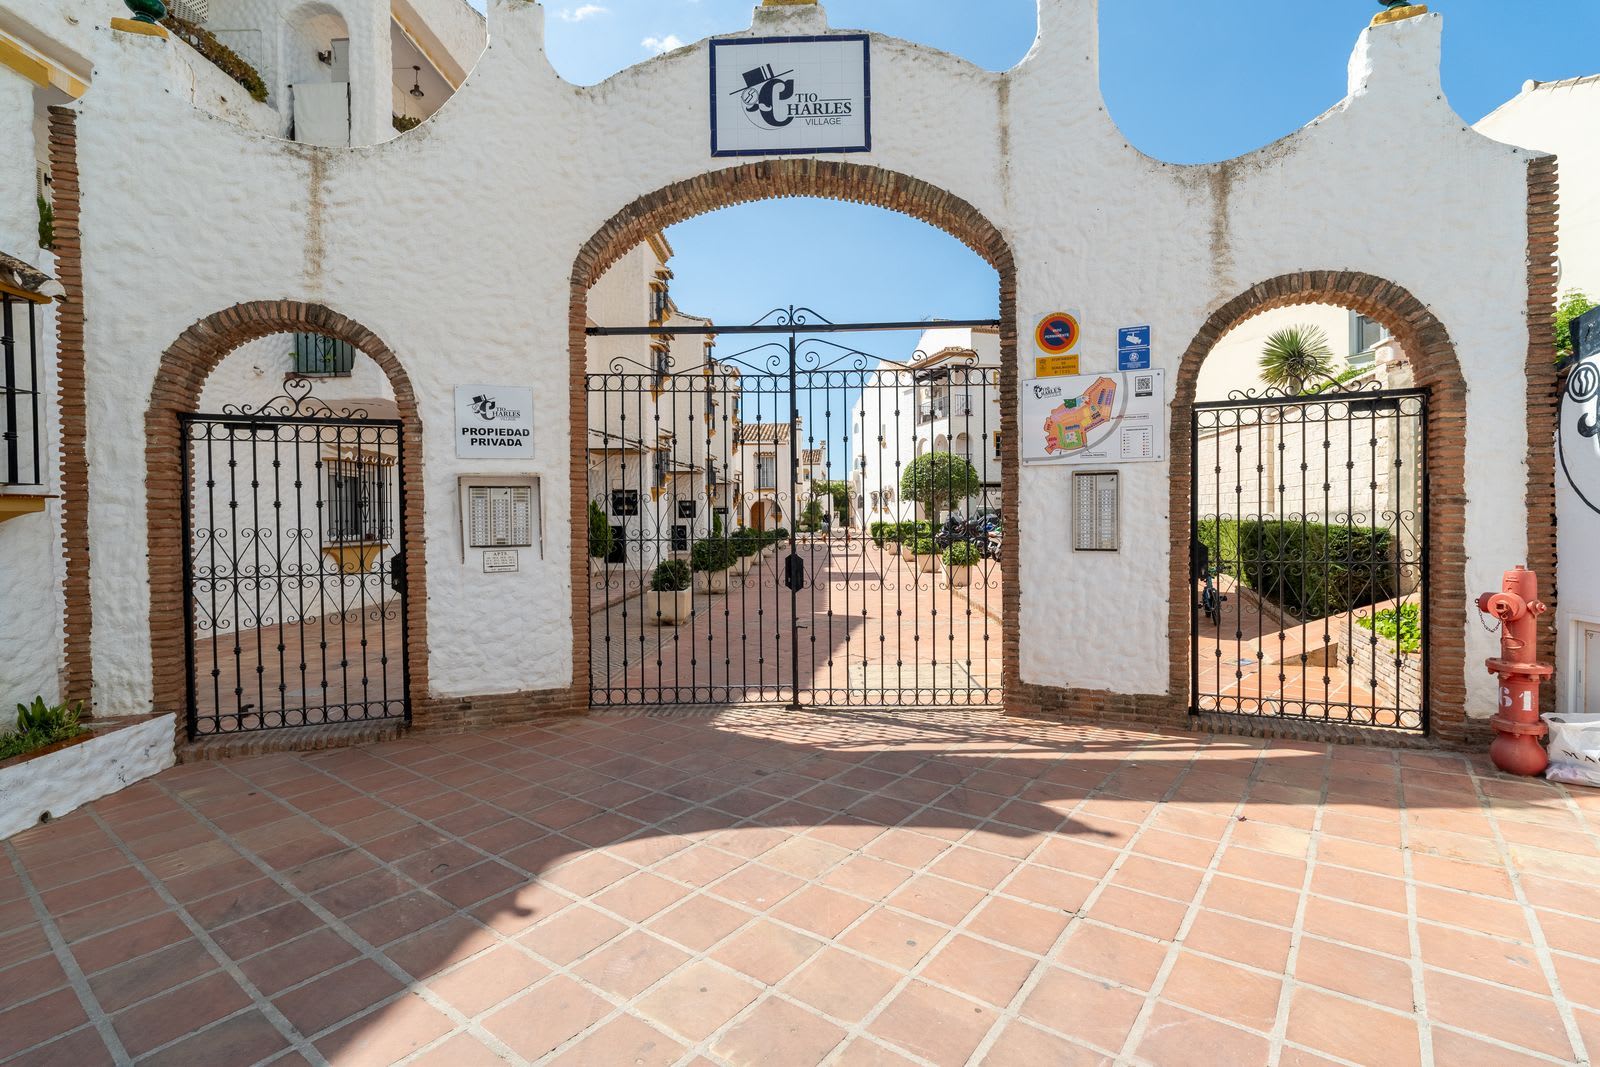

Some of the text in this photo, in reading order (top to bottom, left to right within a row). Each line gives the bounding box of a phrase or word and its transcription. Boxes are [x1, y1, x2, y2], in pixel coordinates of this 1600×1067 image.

[795, 93, 818, 103] TIO
[805, 117, 842, 126] VILLAGE
[462, 427, 530, 437] PROPIEDAD
[470, 438, 523, 447] PRIVADA
